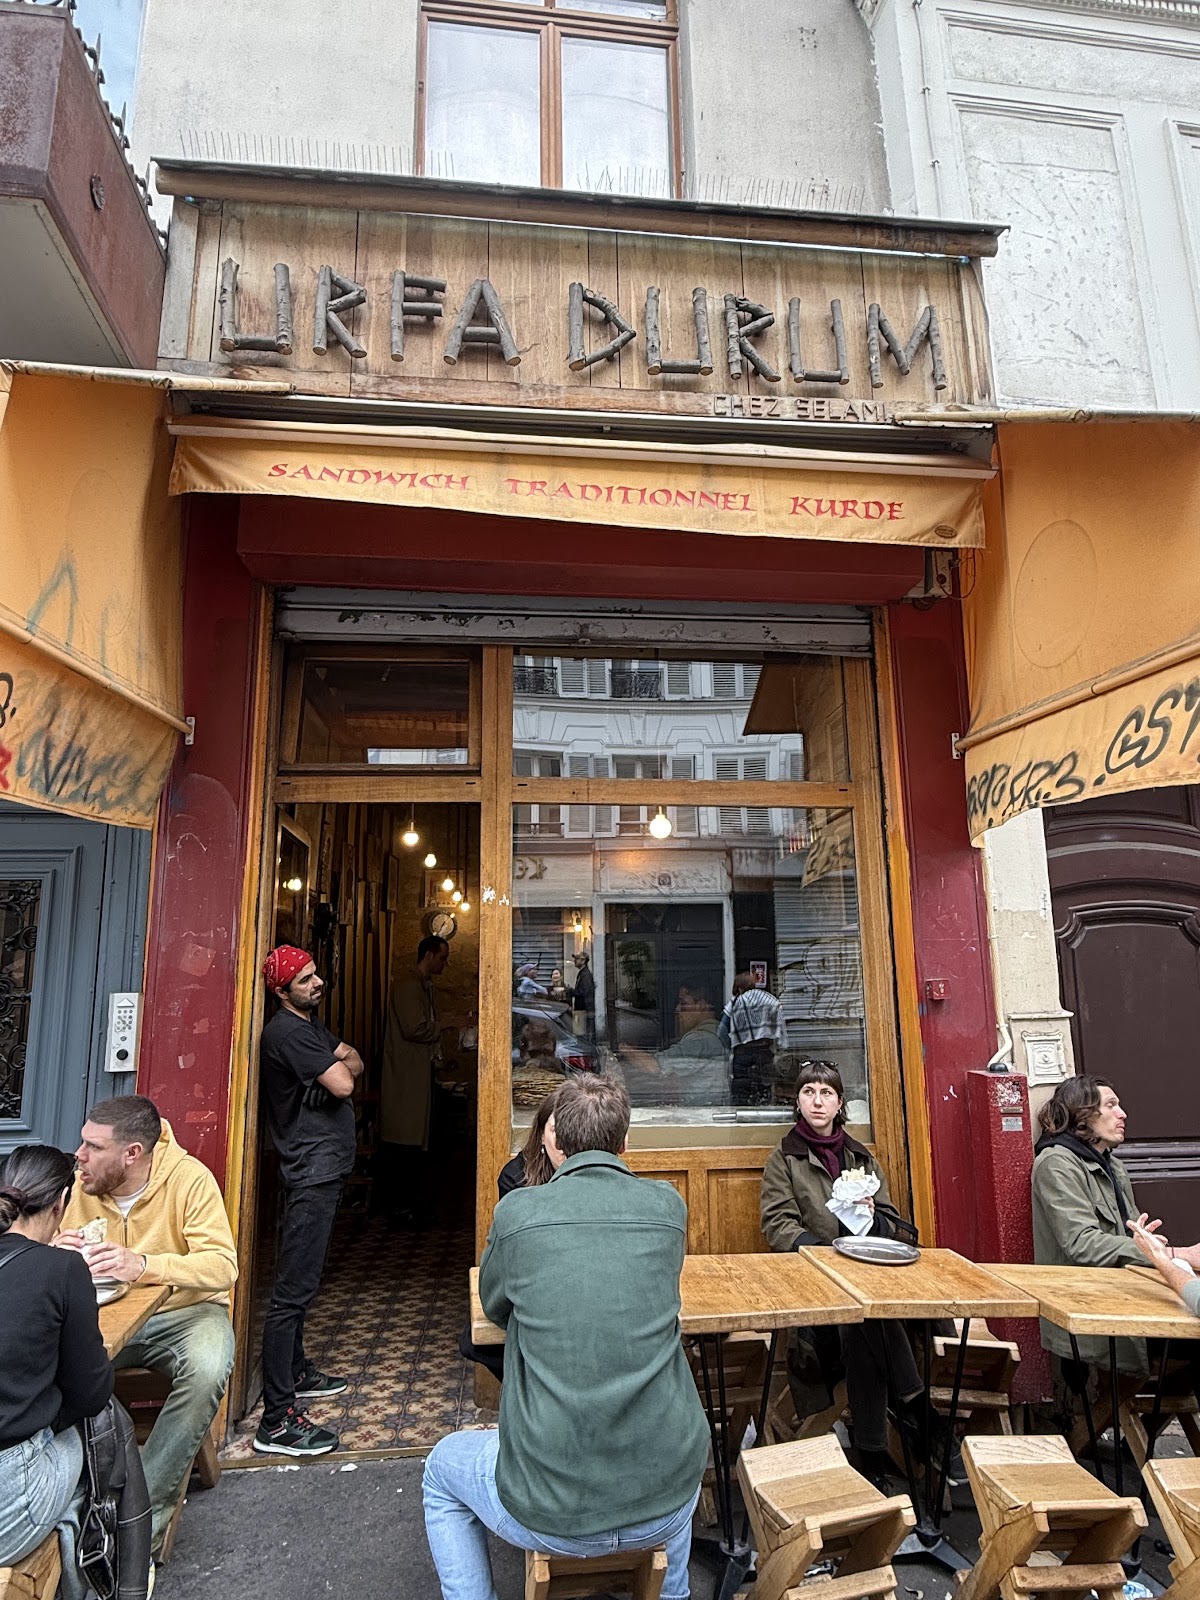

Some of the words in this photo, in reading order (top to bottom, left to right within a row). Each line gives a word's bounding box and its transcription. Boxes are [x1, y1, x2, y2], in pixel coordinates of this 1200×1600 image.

[219, 258, 521, 366] URFA
[569, 281, 947, 390] DURUM
[713, 396, 781, 417] CHEZ
[267, 463, 470, 490] SANDWICH
[504, 478, 758, 512] TRADITIONNEL
[789, 496, 906, 520] KURDE
